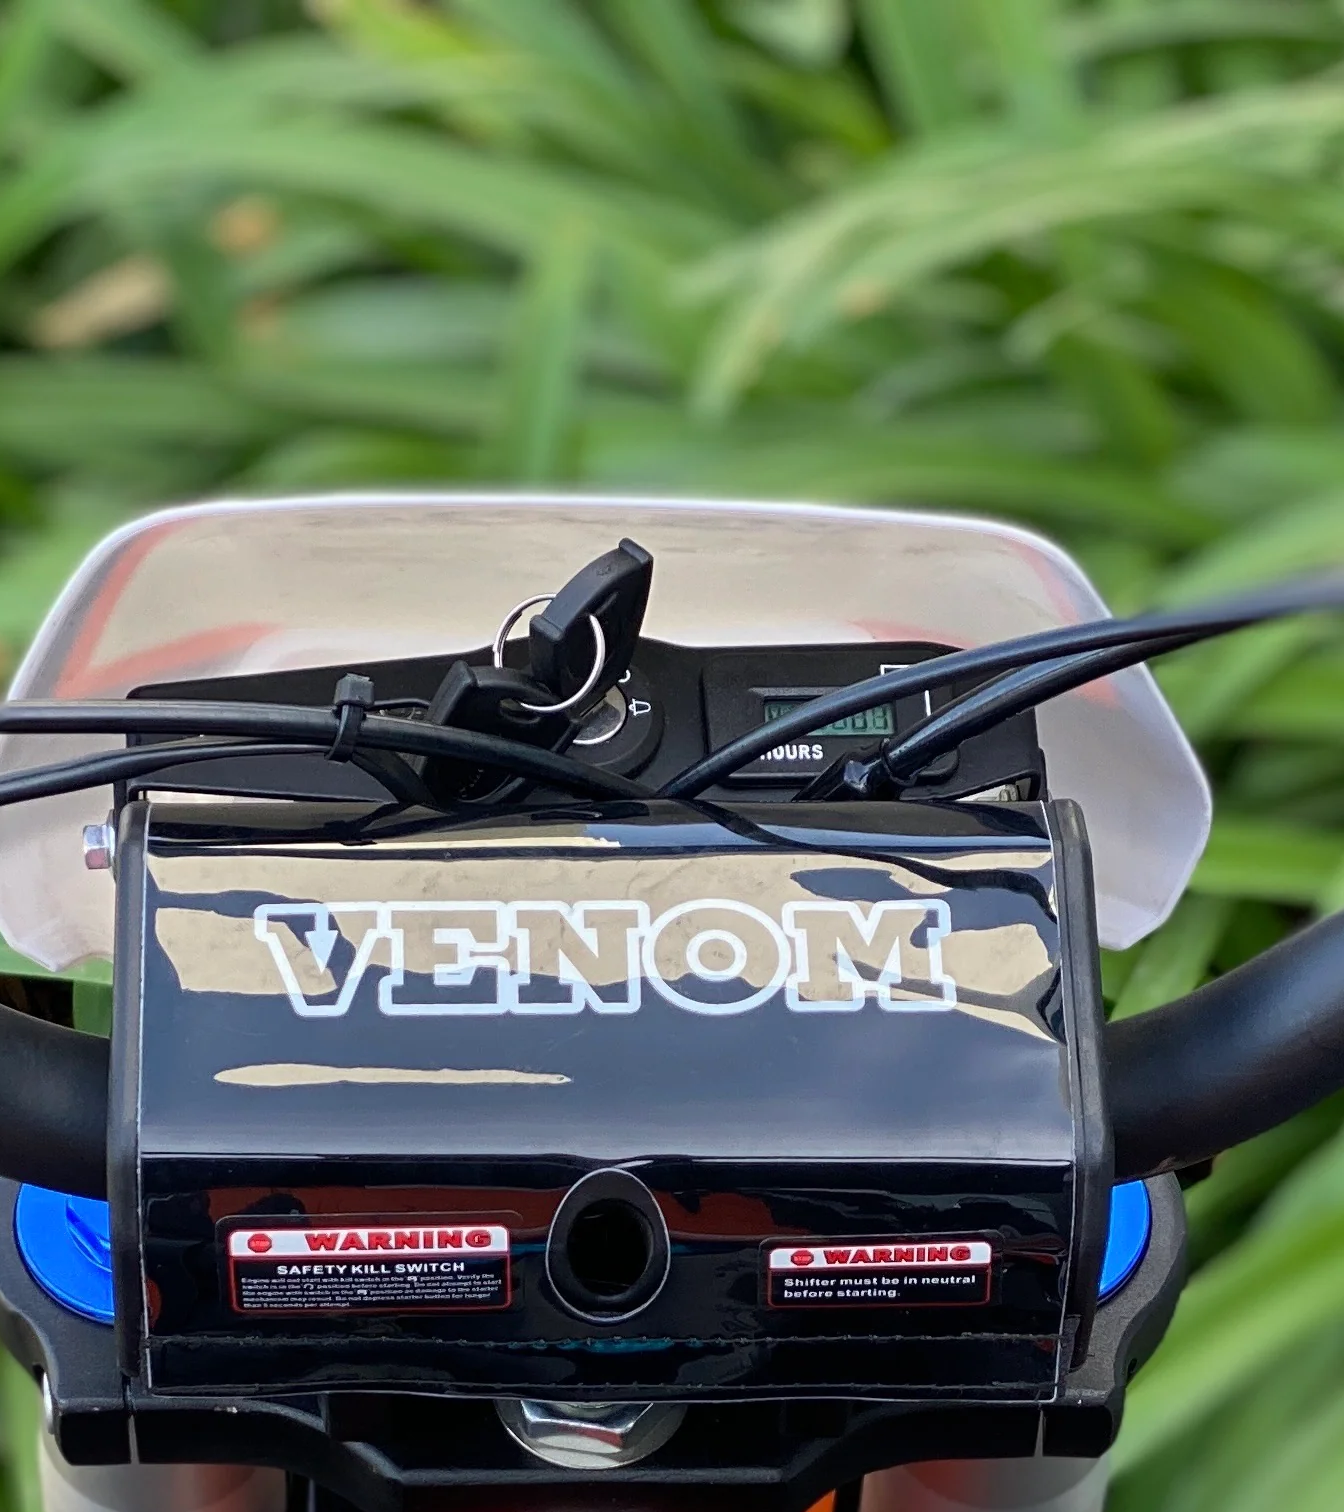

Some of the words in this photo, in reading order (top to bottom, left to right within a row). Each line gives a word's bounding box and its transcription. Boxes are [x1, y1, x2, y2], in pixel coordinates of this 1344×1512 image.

[254, 898, 957, 1017] VENOM
[304, 1228, 493, 1252] WARNING
[822, 1245, 972, 1264] WARNING
[276, 1264, 348, 1275] SAFETY
[351, 1263, 391, 1275] KILL
[394, 1262, 465, 1273] SWITCH
[784, 1276, 837, 1286] Shifter
[840, 1276, 878, 1286] must
[881, 1275, 900, 1285] be
[903, 1275, 918, 1285] in
[921, 1274, 976, 1285] neutral
[784, 1288, 833, 1298] before
[836, 1287, 901, 1299] starting.
